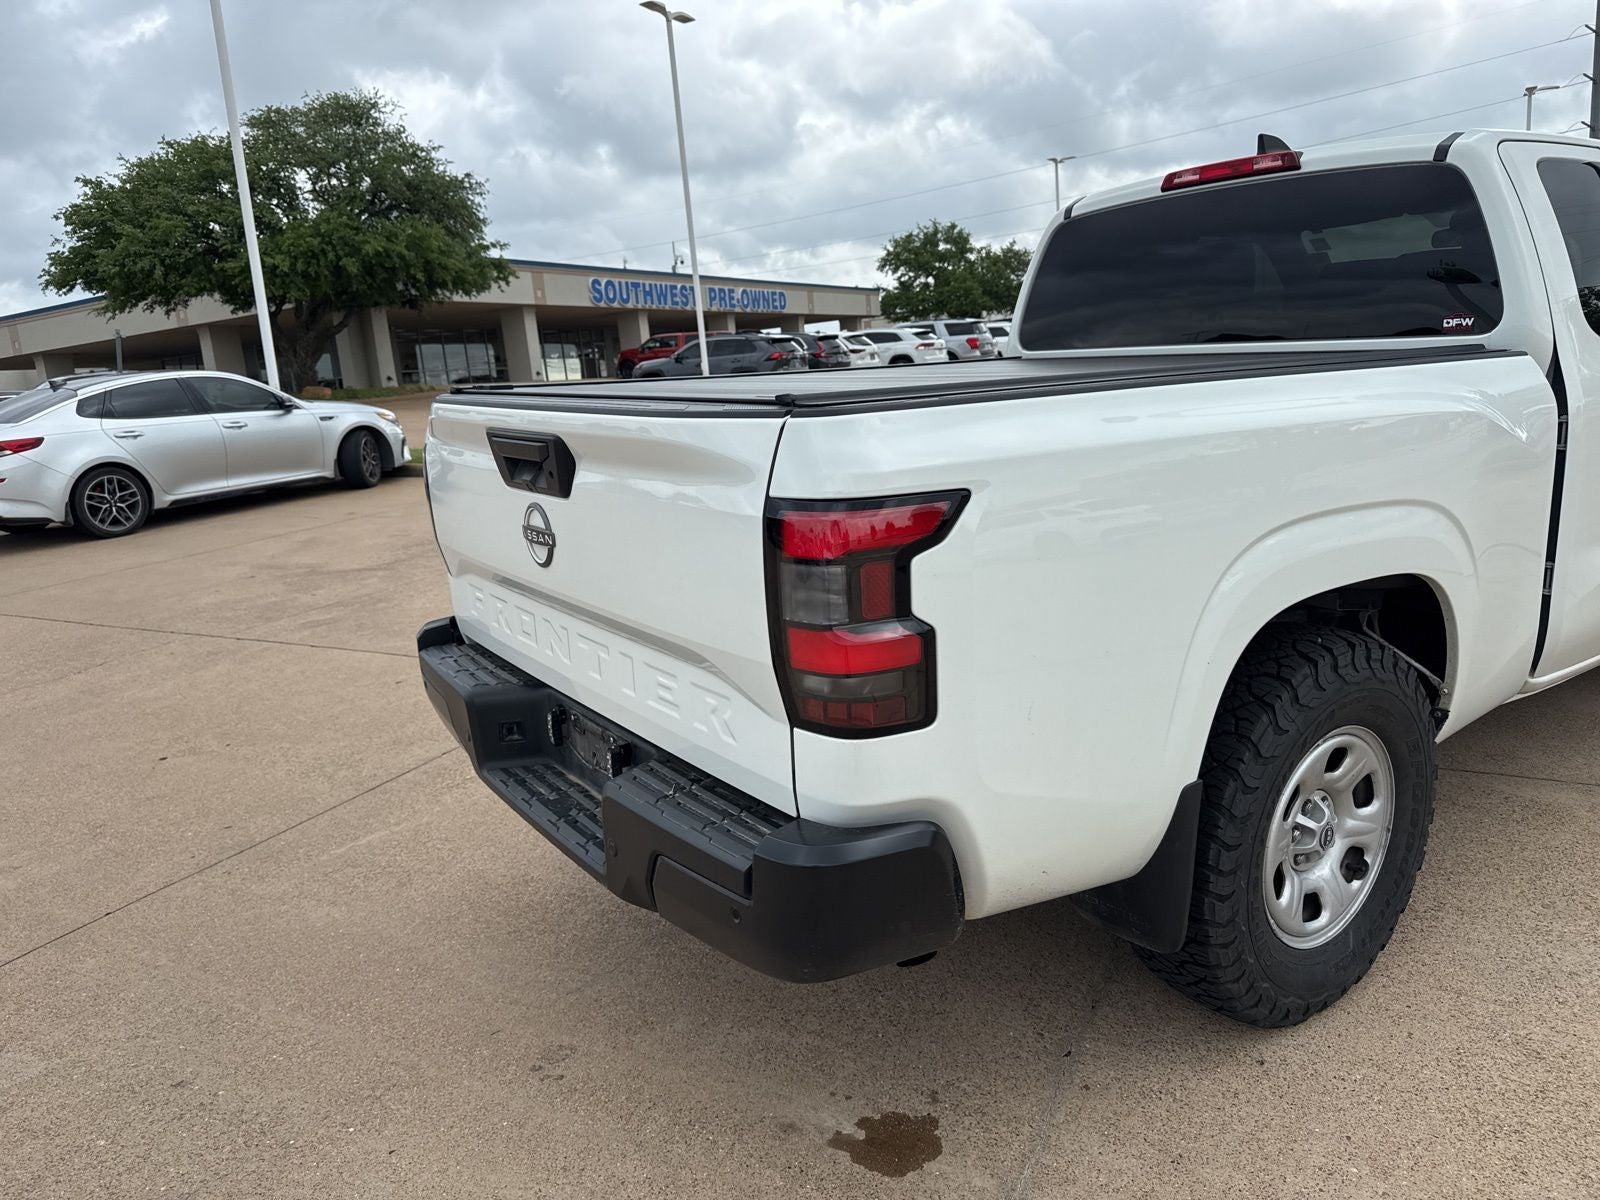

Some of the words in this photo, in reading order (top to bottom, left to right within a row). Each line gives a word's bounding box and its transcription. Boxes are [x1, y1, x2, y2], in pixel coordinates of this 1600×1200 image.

[708, 286, 788, 311] PRE-OWNED
[1443, 317, 1475, 328] DFW
[525, 528, 553, 545] SSAN
[468, 582, 738, 746] FRONTIER
